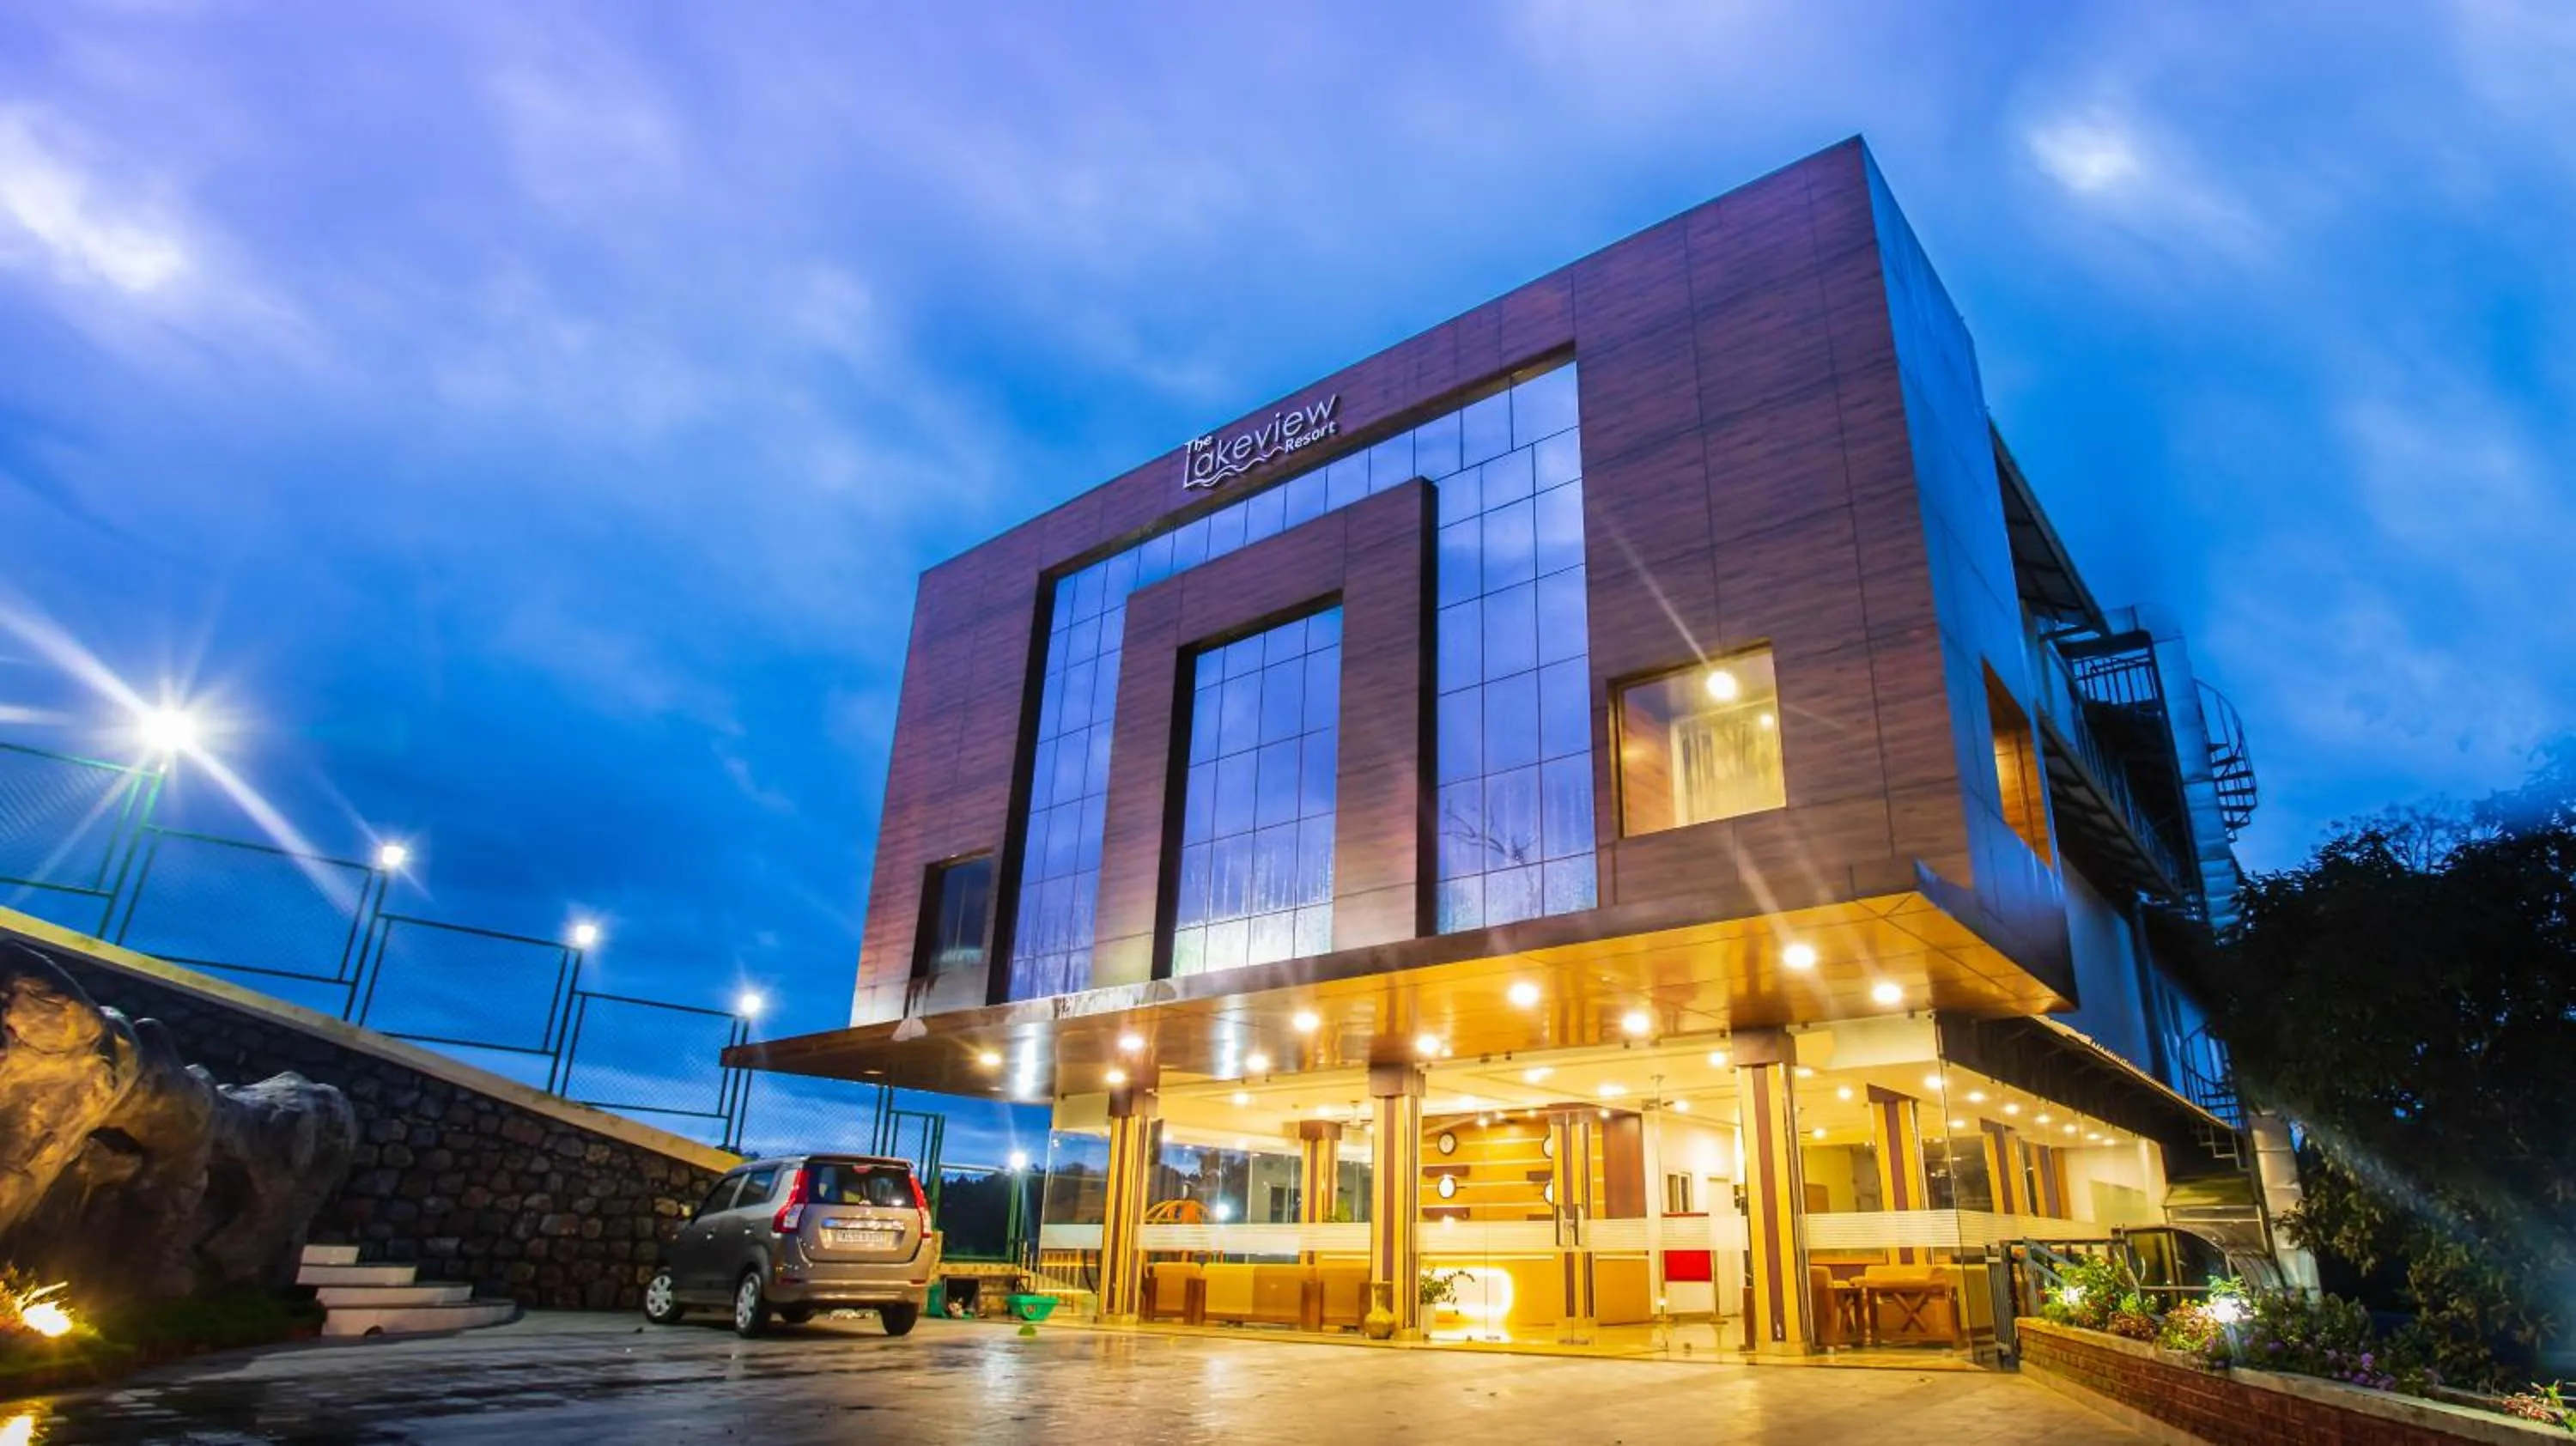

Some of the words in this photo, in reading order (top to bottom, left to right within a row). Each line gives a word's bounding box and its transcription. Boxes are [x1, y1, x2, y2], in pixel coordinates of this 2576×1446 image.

[1183, 394, 1337, 489] Lakeview
[1185, 434, 1212, 453] The
[1285, 421, 1337, 453] Resort
